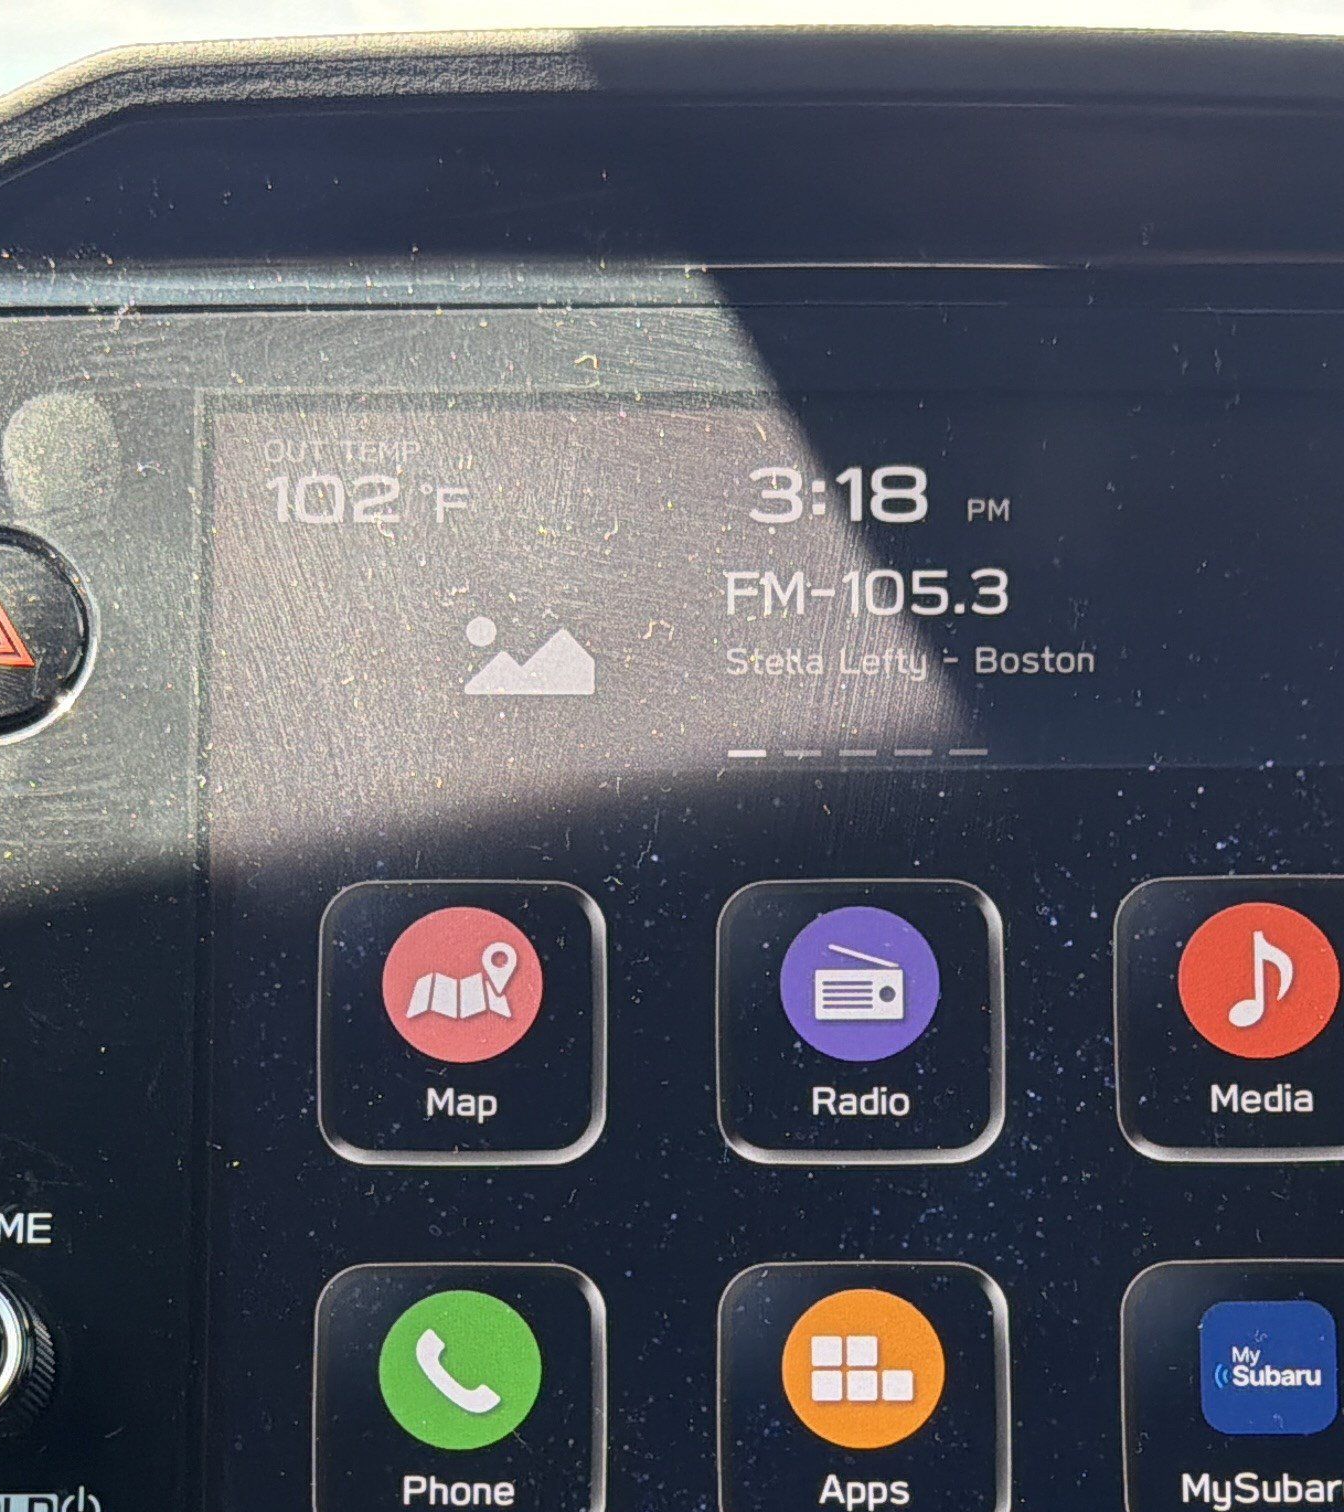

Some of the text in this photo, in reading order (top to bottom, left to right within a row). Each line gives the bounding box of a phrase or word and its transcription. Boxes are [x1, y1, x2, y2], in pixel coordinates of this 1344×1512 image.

[264, 438, 422, 463] OUT TEMP
[266, 474, 401, 524] 102
[748, 465, 1011, 524] 3:18 PM
[724, 567, 1009, 617] FM-105.3
[725, 645, 823, 677] Stella
[840, 645, 930, 682] Lefty
[974, 645, 1096, 675] Boston
[426, 1087, 498, 1124] Map
[812, 1086, 910, 1117] Radio
[1210, 1083, 1314, 1114] Media
[1231, 1346, 1261, 1367] My
[1232, 1365, 1322, 1387] Subaru
[403, 1475, 515, 1506] Phone
[818, 1474, 910, 1512] Apps
